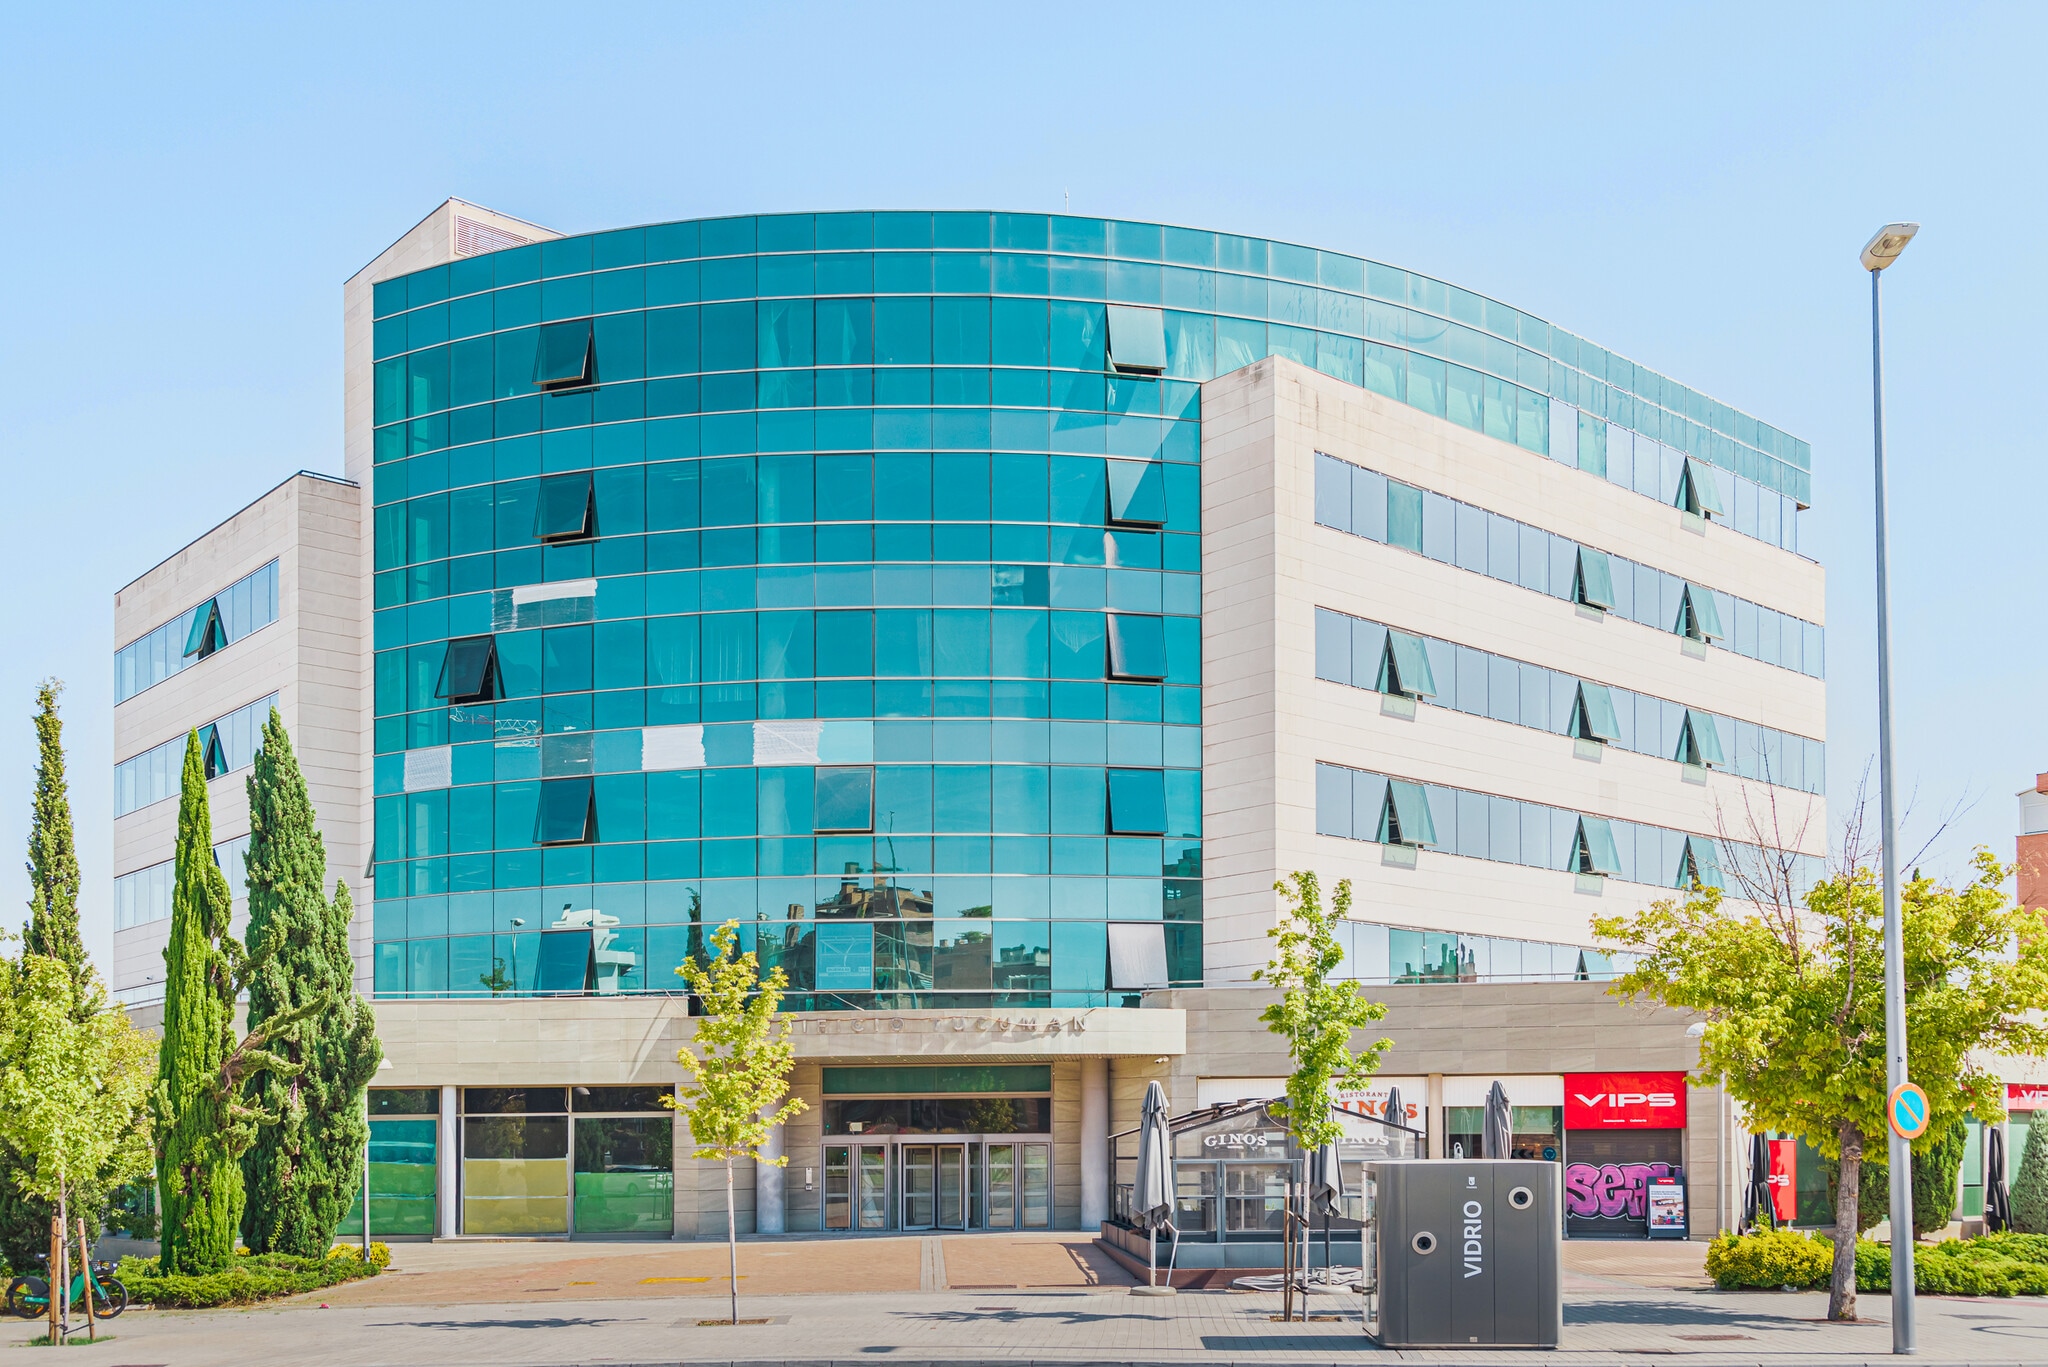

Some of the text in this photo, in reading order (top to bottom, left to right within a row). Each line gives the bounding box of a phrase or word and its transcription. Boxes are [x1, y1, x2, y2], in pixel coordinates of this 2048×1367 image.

[1340, 1091, 1389, 1099] RISTORANT
[1574, 1093, 1677, 1107] VIPS
[1340, 1099, 1419, 1119] INS
[1203, 1133, 1268, 1147] GINOS
[1340, 1134, 1390, 1146] INOS
[1768, 1174, 1790, 1187] PS
[1463, 1200, 1482, 1279] VIDRIO
